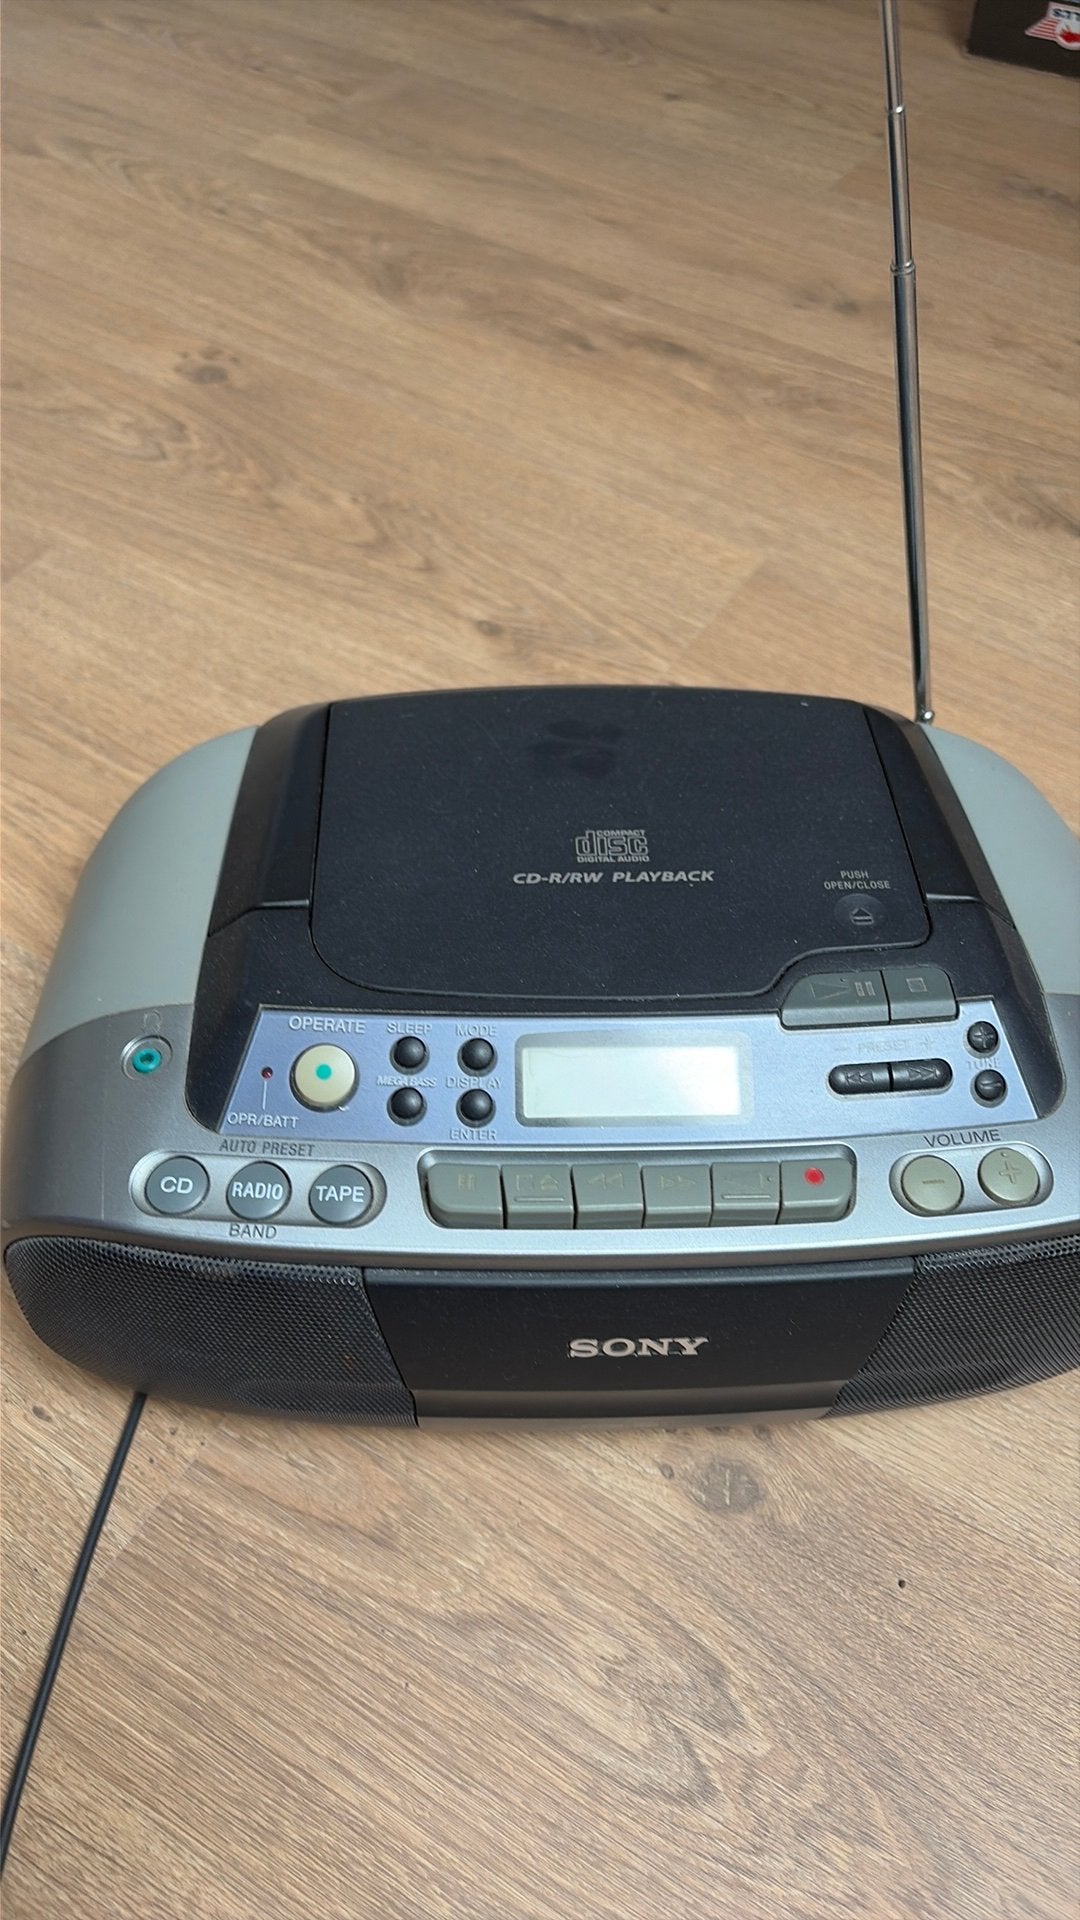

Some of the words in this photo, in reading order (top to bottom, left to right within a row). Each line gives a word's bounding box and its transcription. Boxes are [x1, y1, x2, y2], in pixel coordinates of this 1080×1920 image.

[596, 829, 646, 837] COMPACT
[577, 855, 616, 863] DIGITAL
[617, 855, 650, 863] AUDIO
[513, 872, 604, 885] CD-R/RW
[612, 870, 715, 883] PLAYBACK
[840, 870, 869, 880] PUSH
[824, 880, 891, 890] OPEN/CLOSE
[289, 1016, 366, 1034] OPERATE
[387, 1021, 433, 1035] SLEEP
[457, 1023, 498, 1036] MODE
[967, 1056, 1001, 1072] TUNE
[446, 1076, 503, 1090] DISPLAY
[227, 1111, 299, 1129] OPR/BATT
[450, 1128, 497, 1141] ENTER
[923, 1128, 1001, 1148] VOLUME
[219, 1138, 257, 1154] AUTO
[262, 1140, 316, 1157] PRESET
[160, 1176, 193, 1194] CD
[231, 1182, 284, 1201] RADIO
[315, 1184, 366, 1204] TAPE
[229, 1223, 277, 1239] BAND
[568, 1336, 710, 1359] SONY
